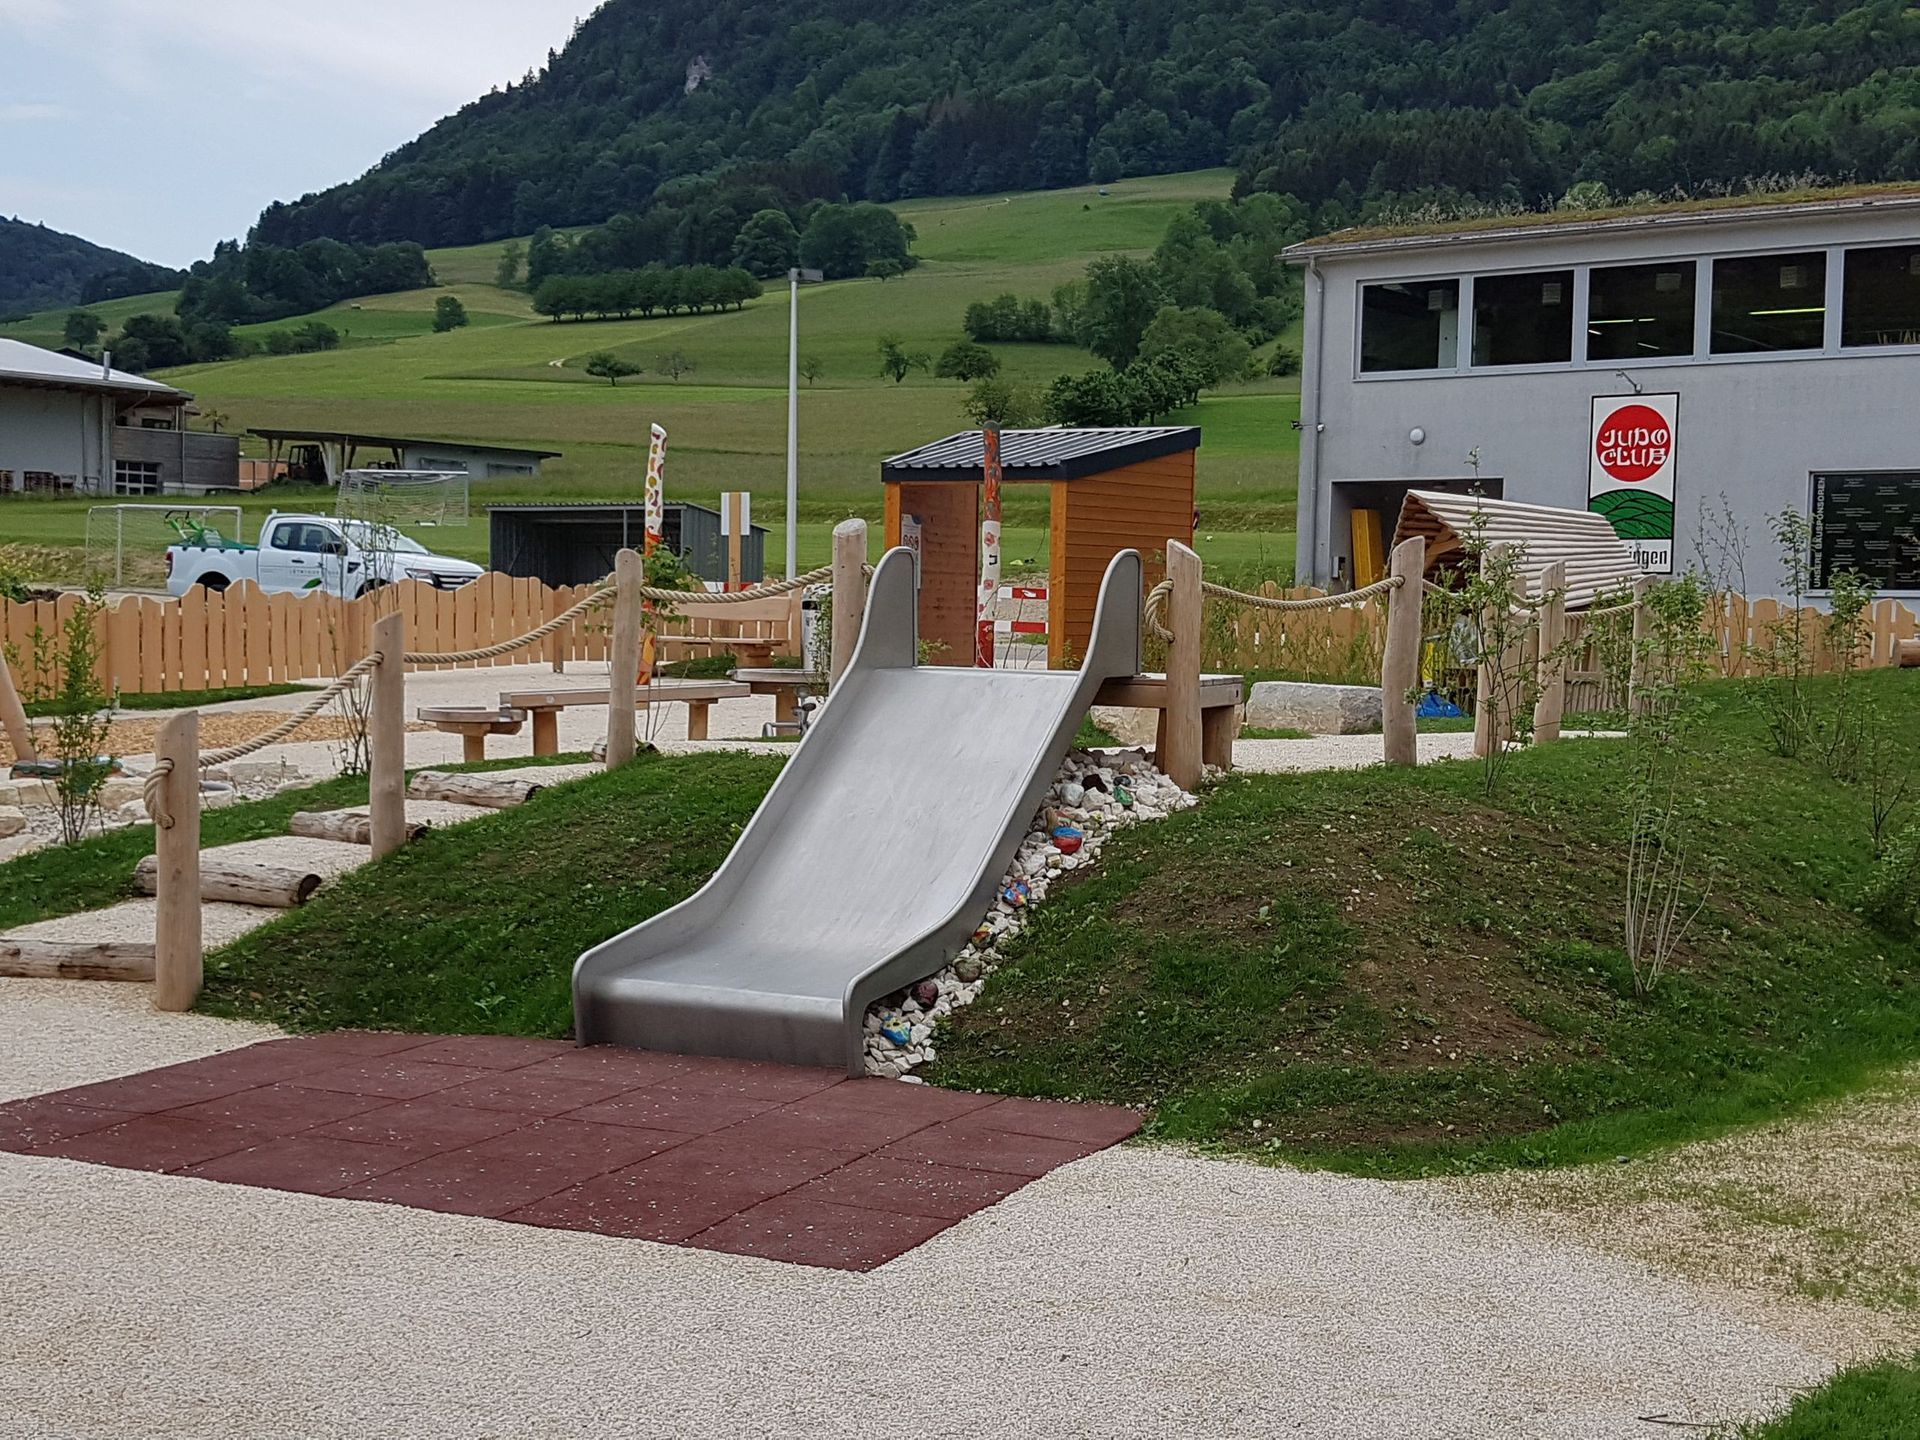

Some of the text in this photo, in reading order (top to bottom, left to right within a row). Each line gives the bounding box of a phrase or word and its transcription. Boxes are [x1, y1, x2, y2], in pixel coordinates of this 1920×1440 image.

[1600, 427, 1668, 447] JUDO
[1599, 447, 1667, 467] CLUB
[1629, 545, 1668, 569] ingen
[1813, 551, 1822, 588] UNSERE
